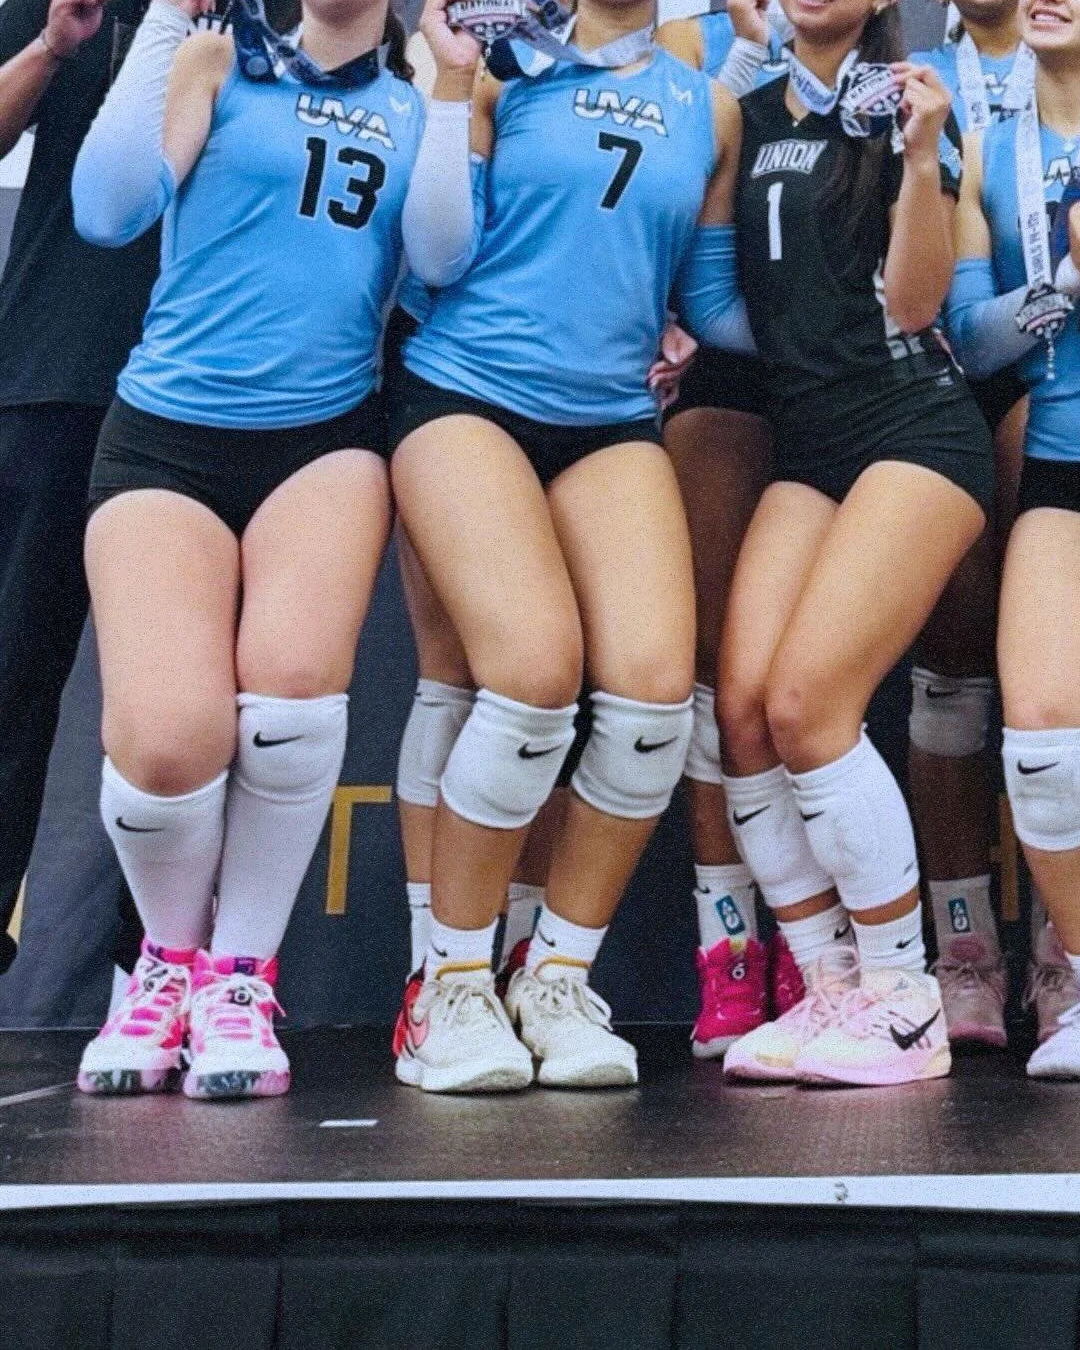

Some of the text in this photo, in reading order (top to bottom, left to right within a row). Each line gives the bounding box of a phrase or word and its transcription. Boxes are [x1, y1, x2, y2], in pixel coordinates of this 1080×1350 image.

[296, 91, 397, 152] UVA
[573, 88, 669, 138] UVA
[298, 135, 387, 231] 13
[598, 131, 643, 210] 7
[751, 138, 828, 179] UNION
[767, 182, 784, 259] 1
